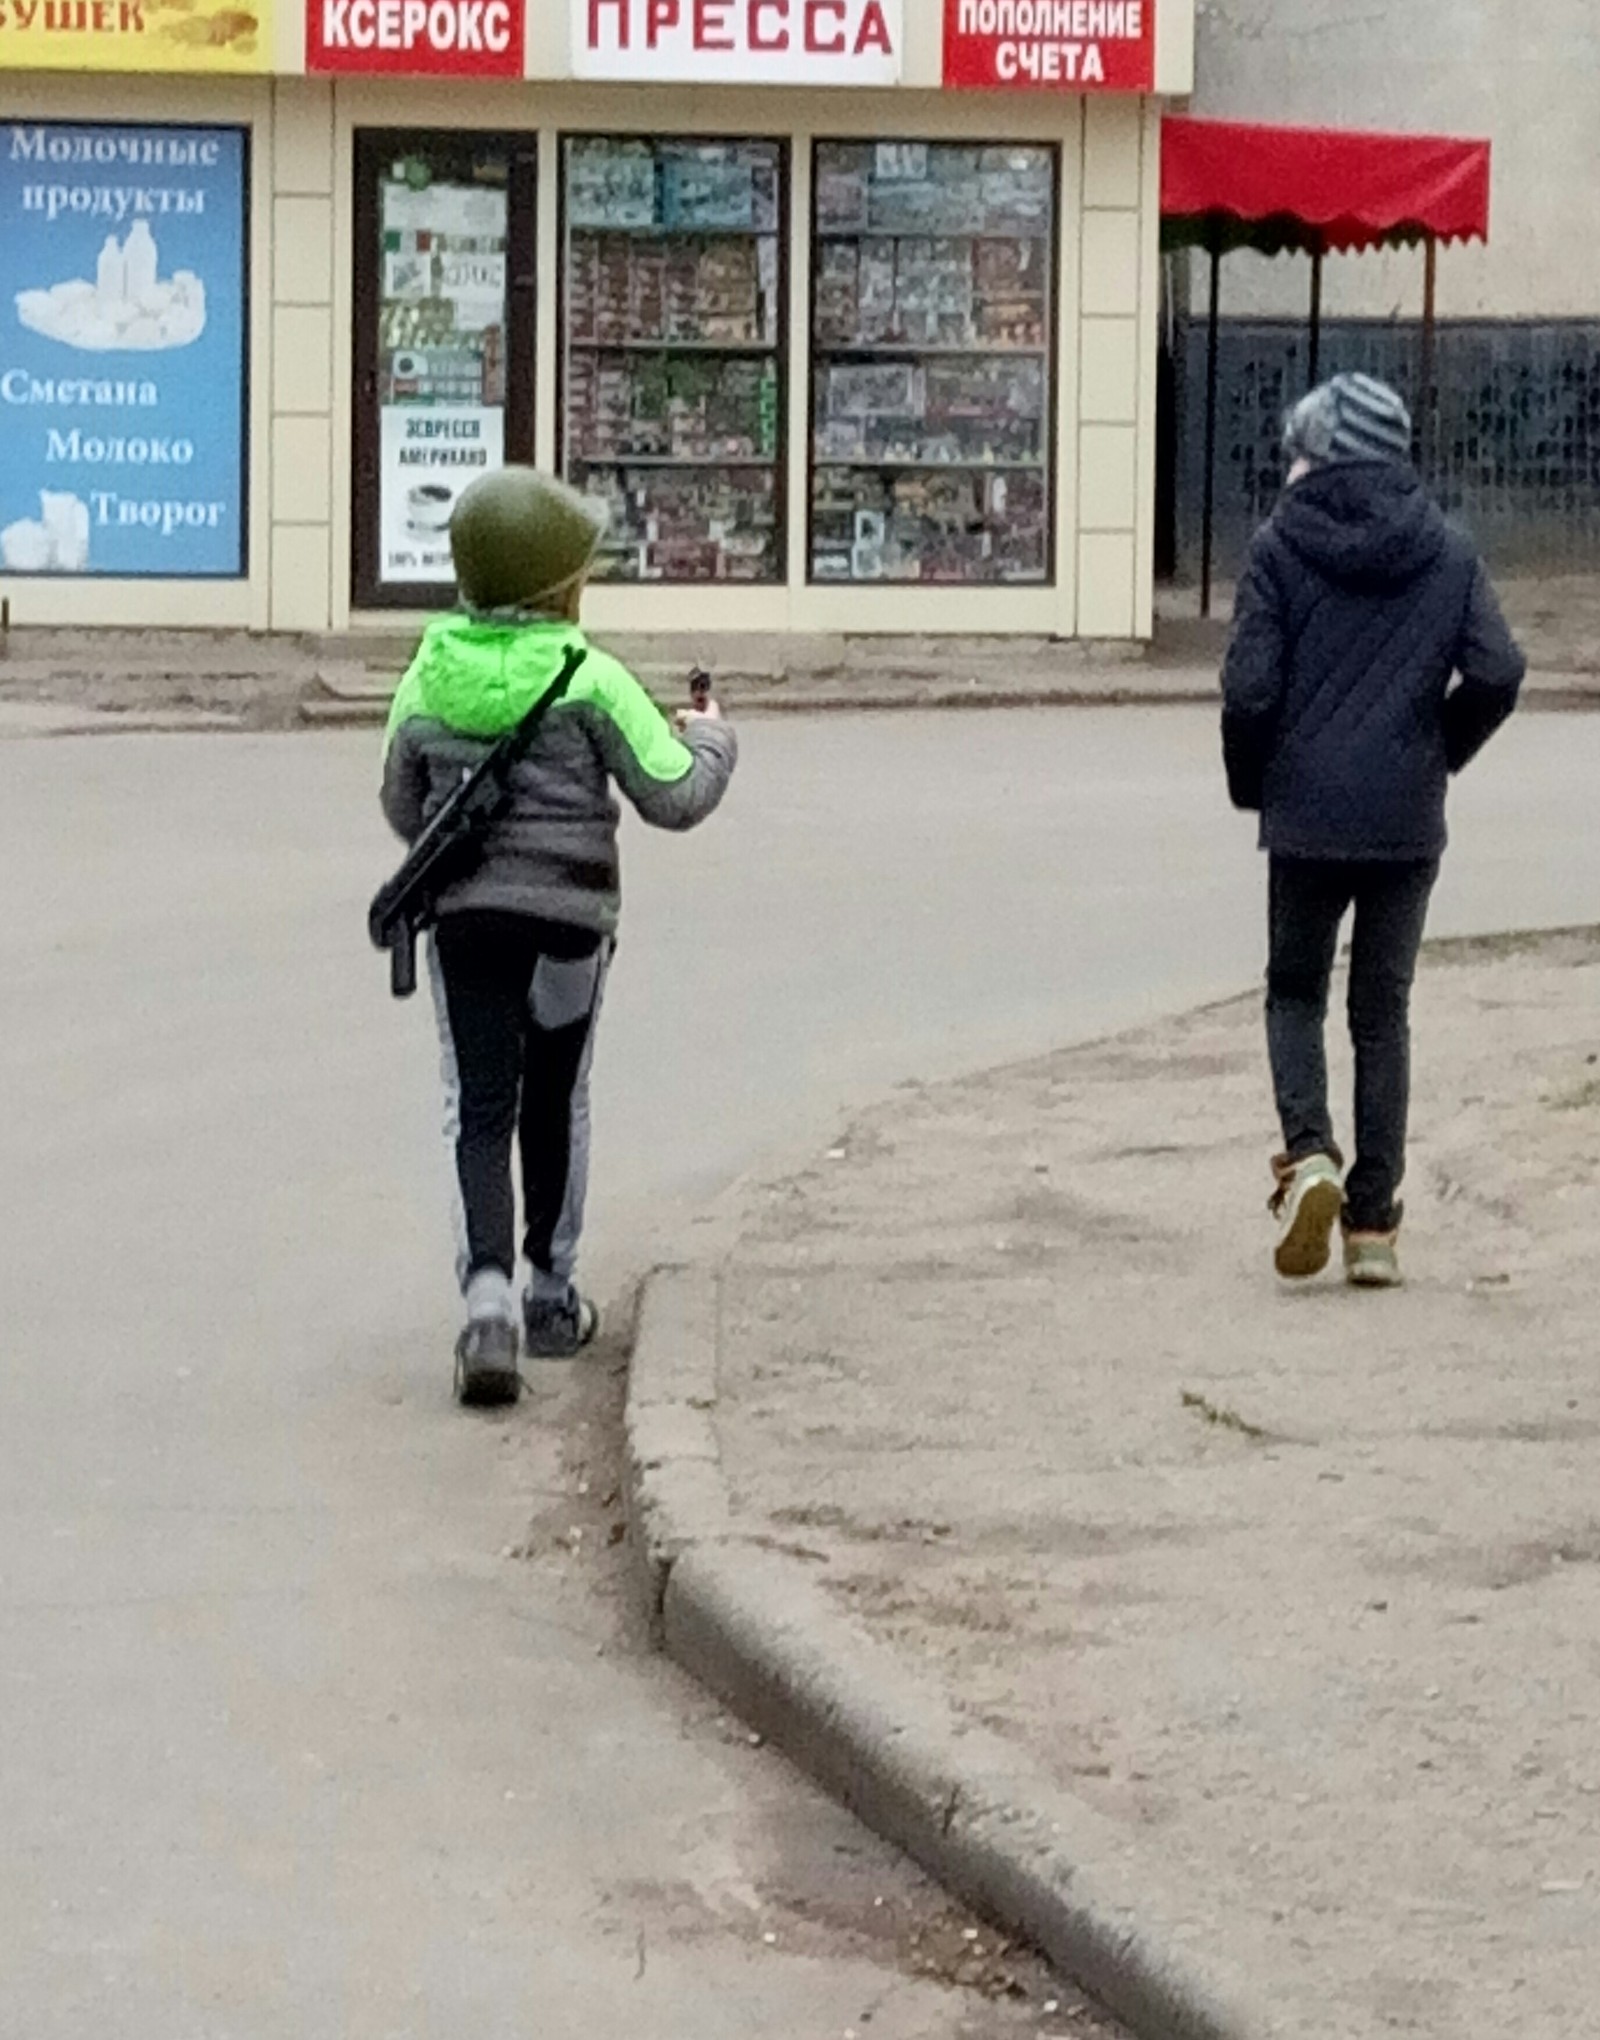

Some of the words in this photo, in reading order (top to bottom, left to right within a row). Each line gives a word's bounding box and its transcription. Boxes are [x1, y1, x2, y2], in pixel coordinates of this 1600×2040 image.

[323, 0, 510, 51] КСЕРОКС
[587, 0, 893, 55] ПРЕССА
[958, 0, 1142, 39] ПОПОЛНЕНИЕ
[995, 41, 1105, 82] СЧЕТА
[9, 126, 220, 166] Молочные
[22, 184, 205, 221] продукты
[1, 368, 158, 406] Сметана
[46, 428, 194, 464] Молоко
[90, 490, 227, 536] Творог
